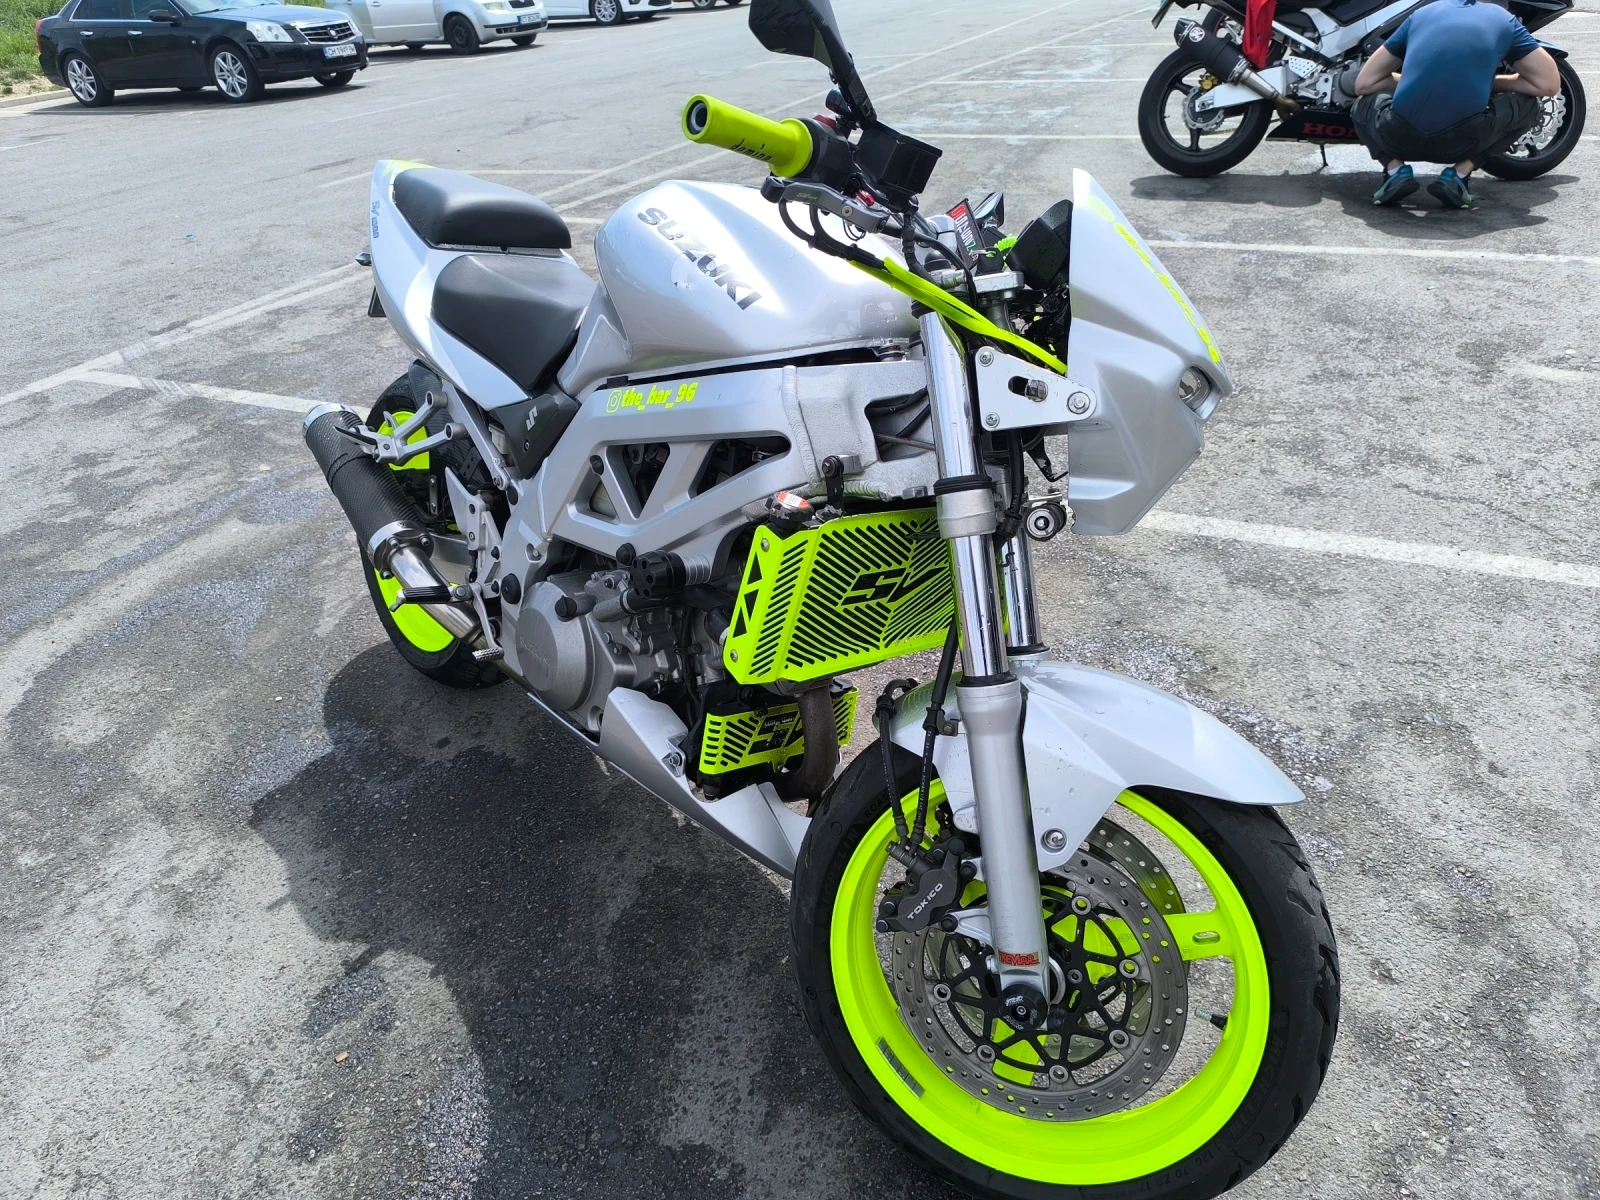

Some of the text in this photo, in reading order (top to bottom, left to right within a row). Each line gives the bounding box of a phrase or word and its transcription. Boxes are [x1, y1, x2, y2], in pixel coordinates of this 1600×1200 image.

[637, 207, 762, 310] SUZUKI
[621, 382, 698, 410] the_bar_96
[907, 883, 943, 919] TOKICO
